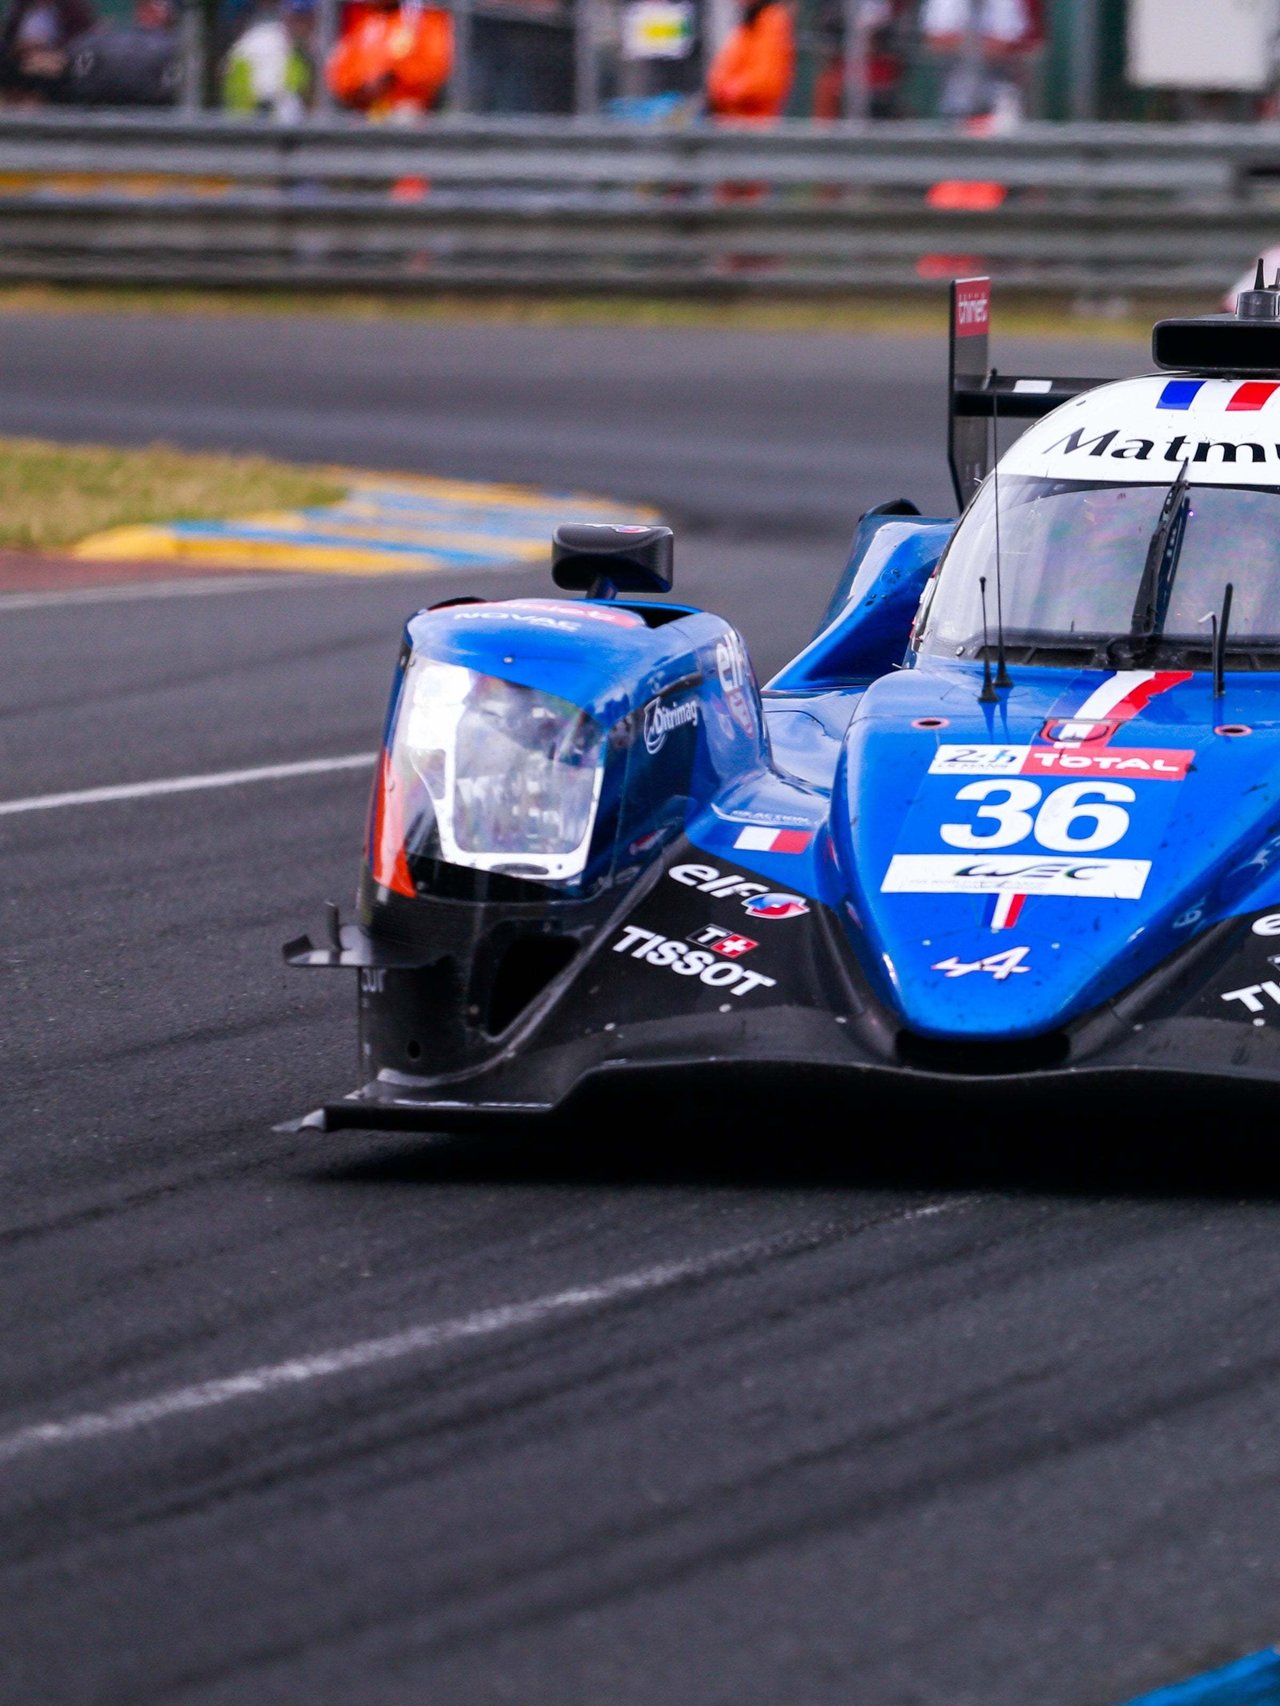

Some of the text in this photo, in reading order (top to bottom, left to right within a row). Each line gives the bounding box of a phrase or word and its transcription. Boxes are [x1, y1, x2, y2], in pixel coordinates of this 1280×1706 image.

[1034, 752, 1179, 772] TOTAL
[940, 778, 1136, 852] 36
[668, 864, 770, 898] elf
[613, 925, 777, 996] TISSOT
